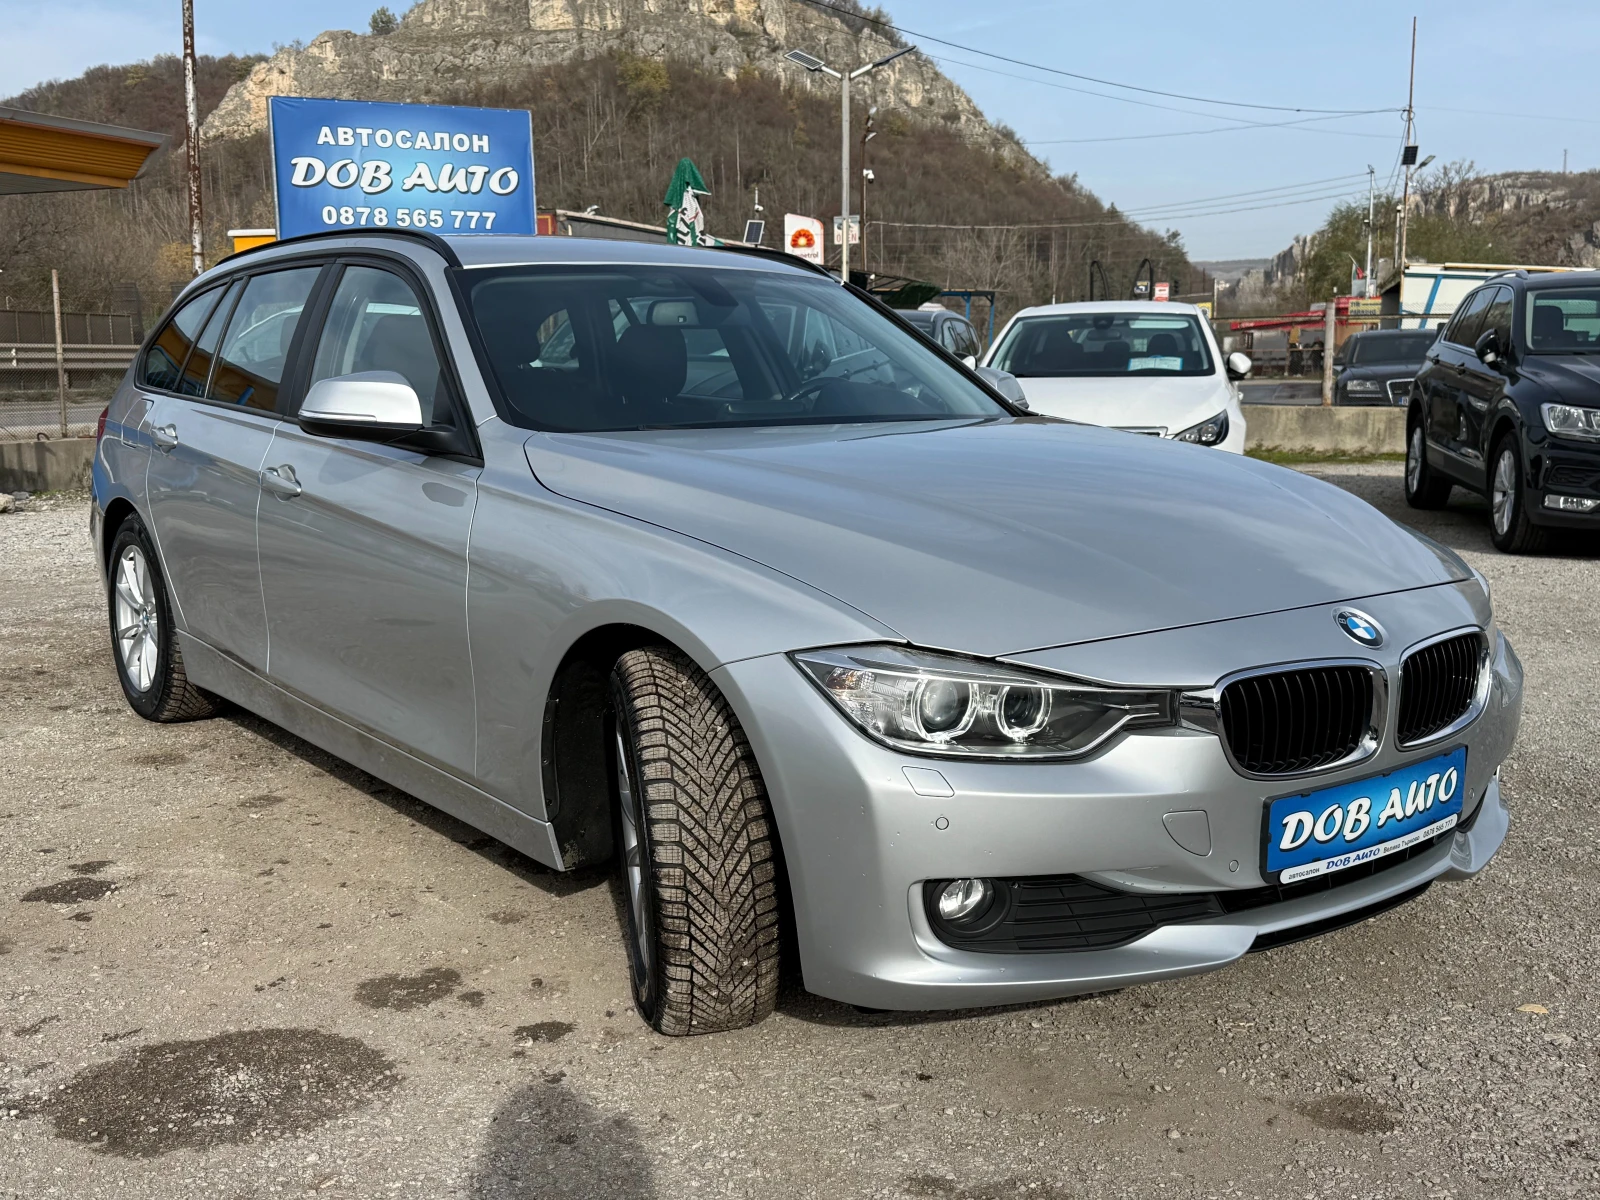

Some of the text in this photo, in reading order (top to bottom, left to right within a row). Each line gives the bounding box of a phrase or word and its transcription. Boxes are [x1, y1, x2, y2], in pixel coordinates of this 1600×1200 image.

[316, 126, 490, 153] АВТОСАЛОН
[290, 156, 519, 195] DOB AUTO
[321, 205, 497, 230] 0878 565 777
[1279, 766, 1458, 851] DOB AUTO
[1288, 867, 1320, 880] автосалон
[1325, 856, 1351, 870] DOB
[1352, 847, 1380, 863] AUTO
